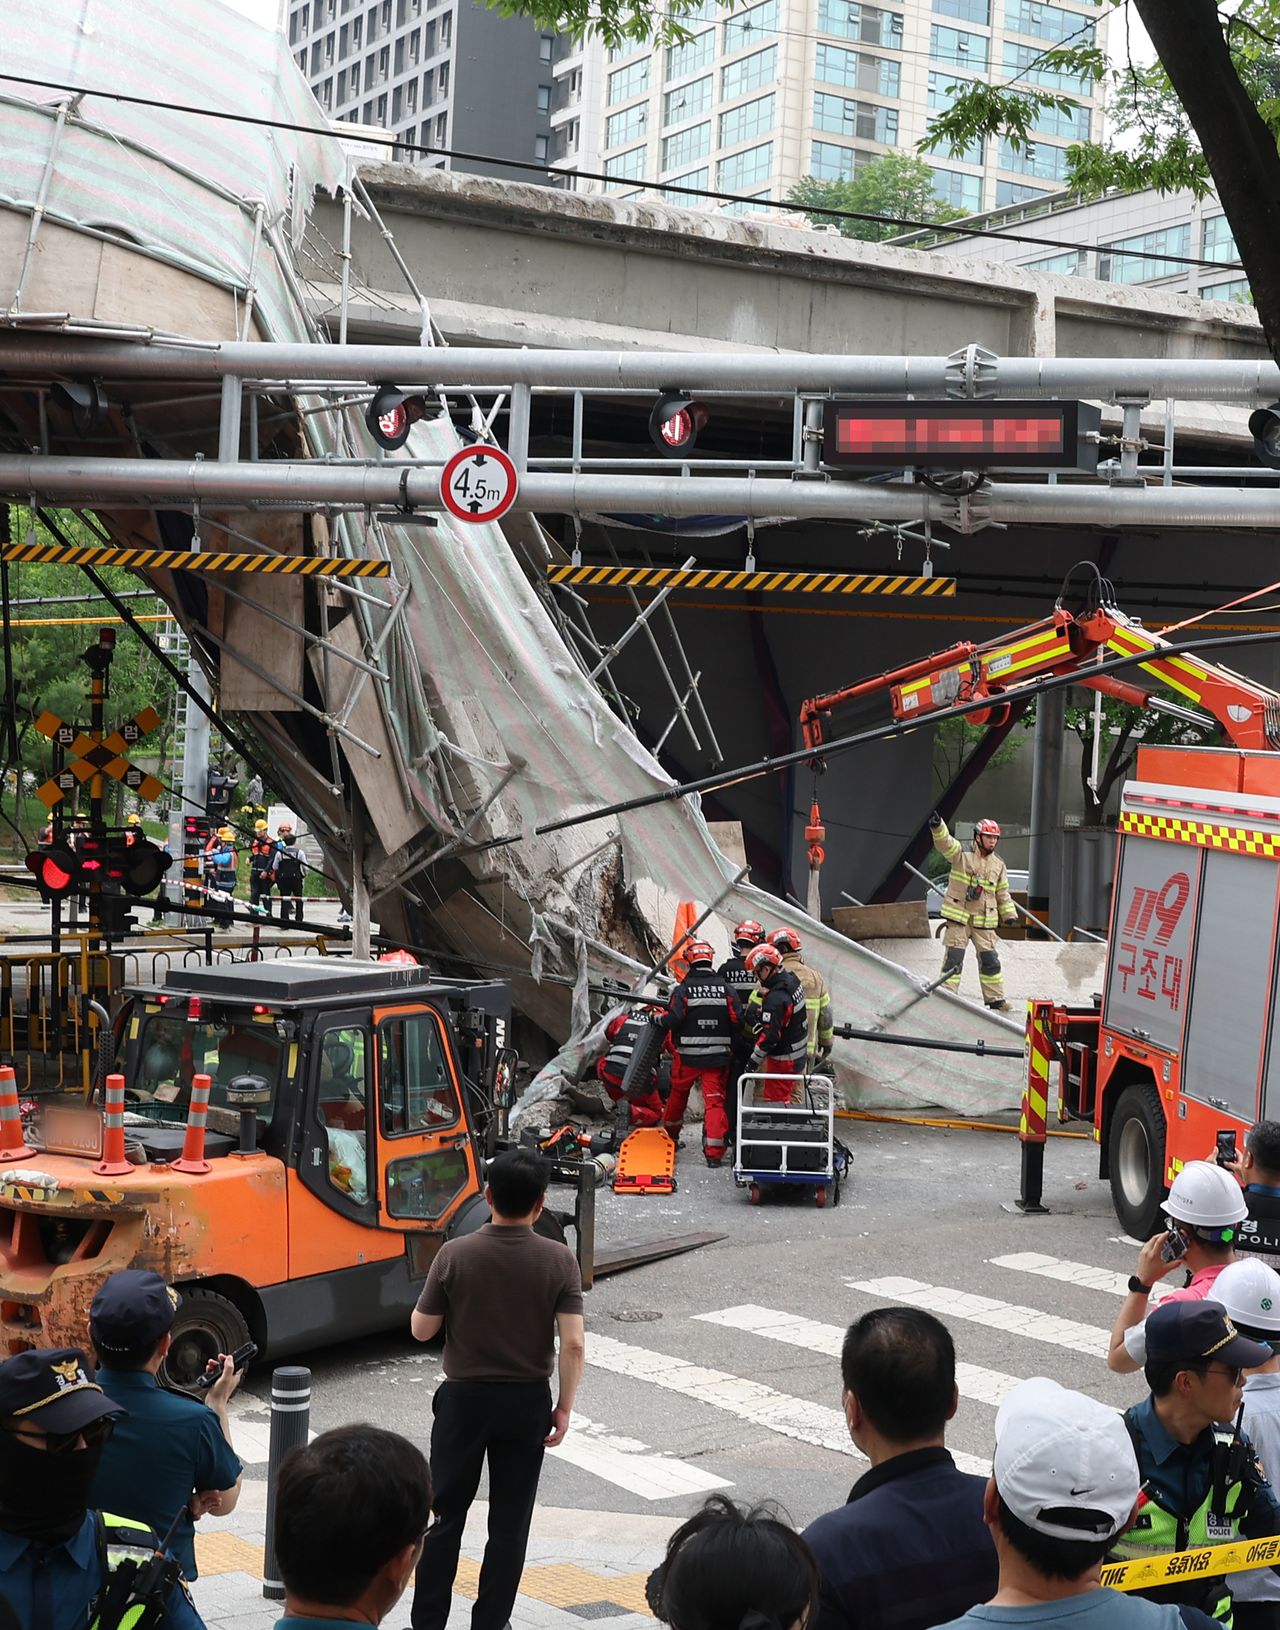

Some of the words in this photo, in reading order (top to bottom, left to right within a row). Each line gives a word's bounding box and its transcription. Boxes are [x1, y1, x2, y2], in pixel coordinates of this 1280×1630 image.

[453, 467, 501, 501] 4.5m
[59, 728, 73, 742] 멈
[125, 725, 138, 739] 멈
[1122, 872, 1190, 947] 119
[1118, 942, 1183, 1011] 구조대
[688, 985, 725, 993] 119구조대
[1238, 1233, 1279, 1247] POLI
[1208, 1527, 1231, 1536] POLICE
